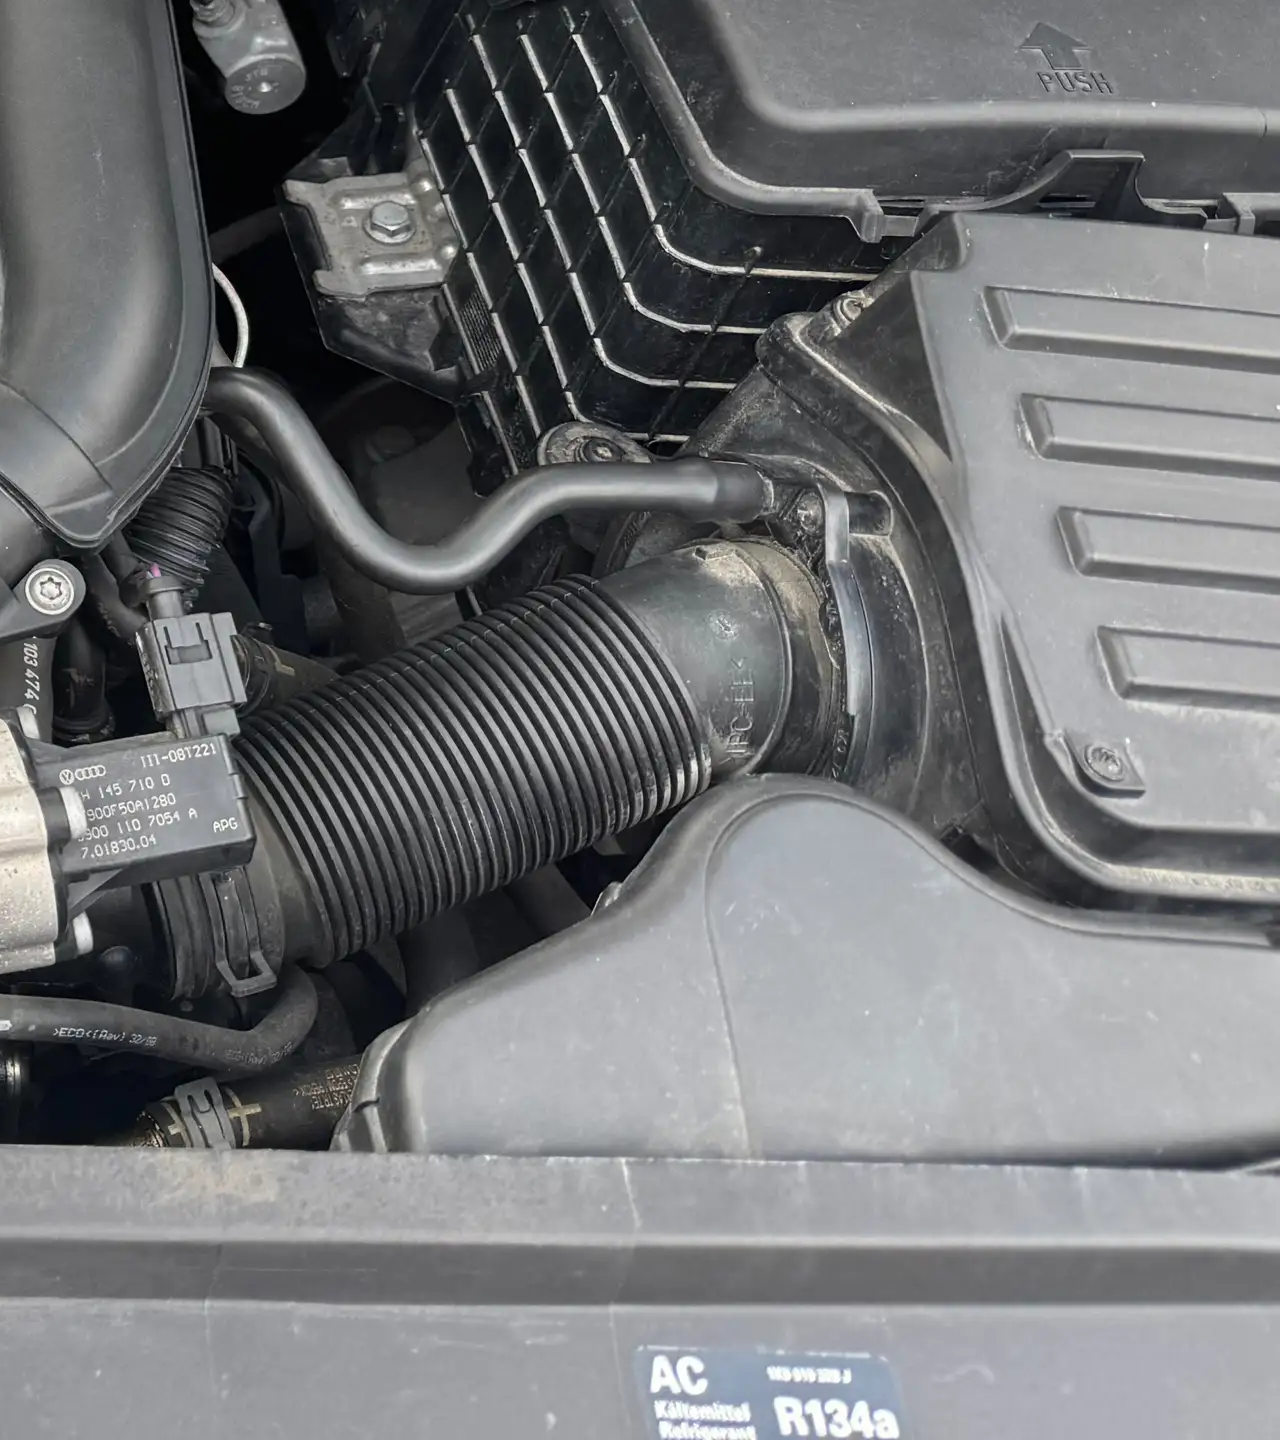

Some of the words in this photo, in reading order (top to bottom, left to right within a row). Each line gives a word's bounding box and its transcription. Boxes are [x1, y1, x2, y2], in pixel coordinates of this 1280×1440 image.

[1036, 71, 1115, 94] PUSH
[23, 642, 39, 667] 103
[98, 782, 123, 800] 145
[127, 776, 155, 793] 710
[117, 817, 142, 835] 110
[147, 810, 181, 828] 7054
[188, 807, 199, 820] A
[212, 816, 239, 833] APG
[80, 833, 158, 860] 7.01830.04
[649, 1354, 709, 1395] AC
[653, 1399, 752, 1423] Kältemittel
[772, 1395, 901, 1440] R134a
